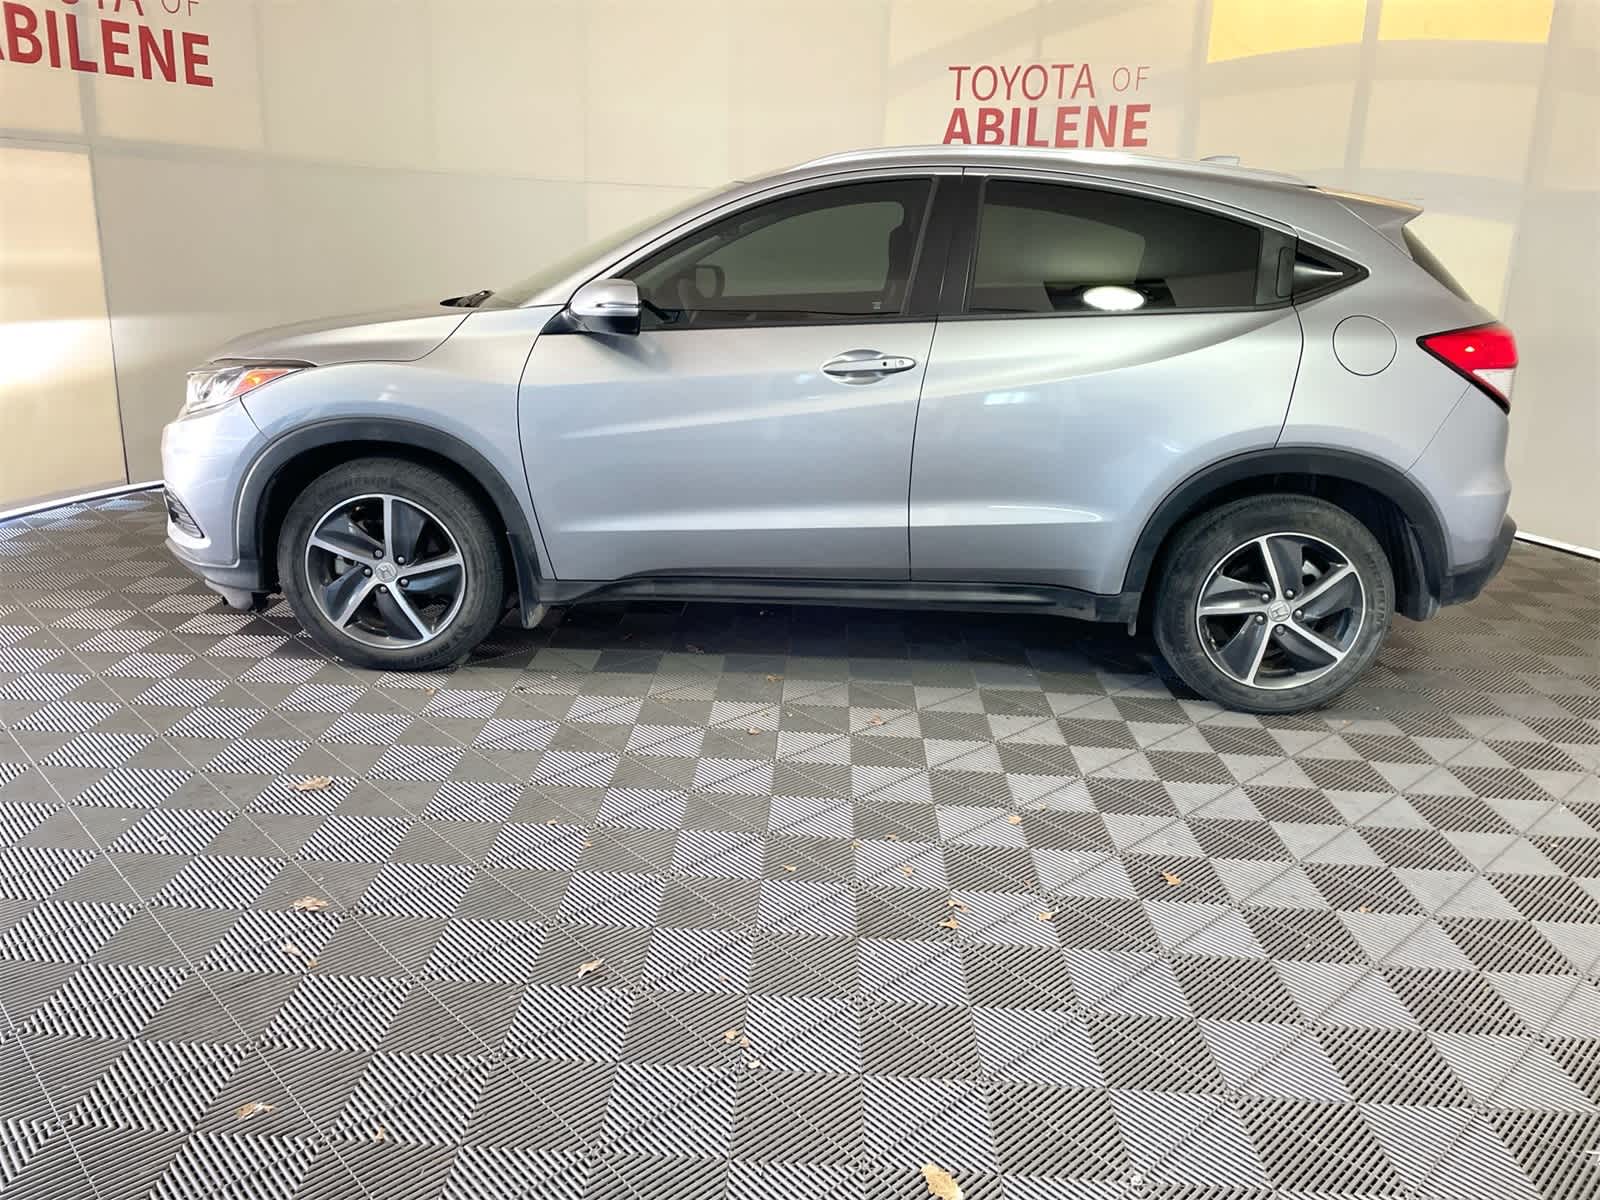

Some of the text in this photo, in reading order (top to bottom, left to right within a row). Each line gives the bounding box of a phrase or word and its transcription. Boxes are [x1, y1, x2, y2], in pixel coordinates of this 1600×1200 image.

[0, 0, 214, 87] BILENE
[948, 63, 1151, 101] TOYOTA OF
[942, 103, 1152, 148] ABILENE
